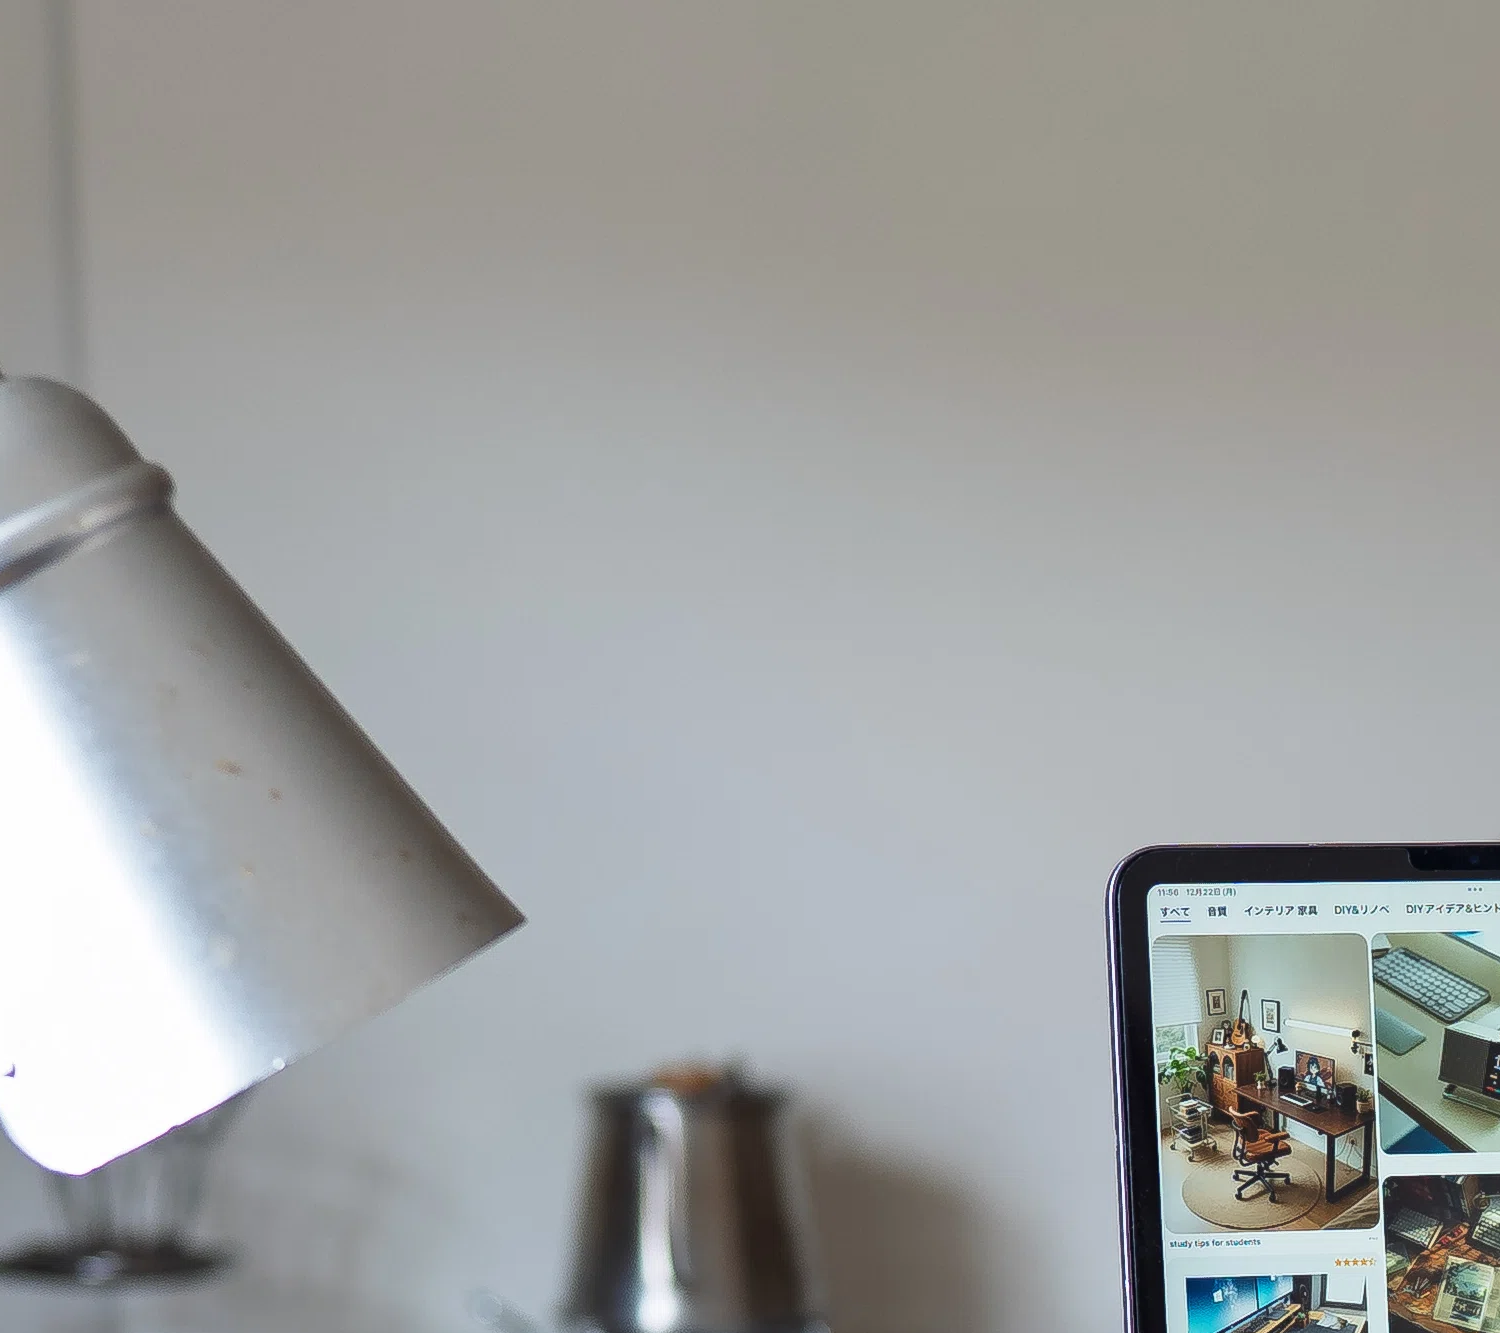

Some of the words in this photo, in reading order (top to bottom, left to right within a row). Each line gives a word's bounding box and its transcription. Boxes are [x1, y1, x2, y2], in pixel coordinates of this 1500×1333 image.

[1160, 906, 1191, 917] すべて
[1244, 905, 1293, 917] インテリア
[1334, 904, 1390, 916] DIY&リノベ
[1169, 1240, 1193, 1249] study
[1194, 1239, 1210, 1248] tips
[1211, 1239, 1224, 1247] for
[1225, 1238, 1261, 1247] students
